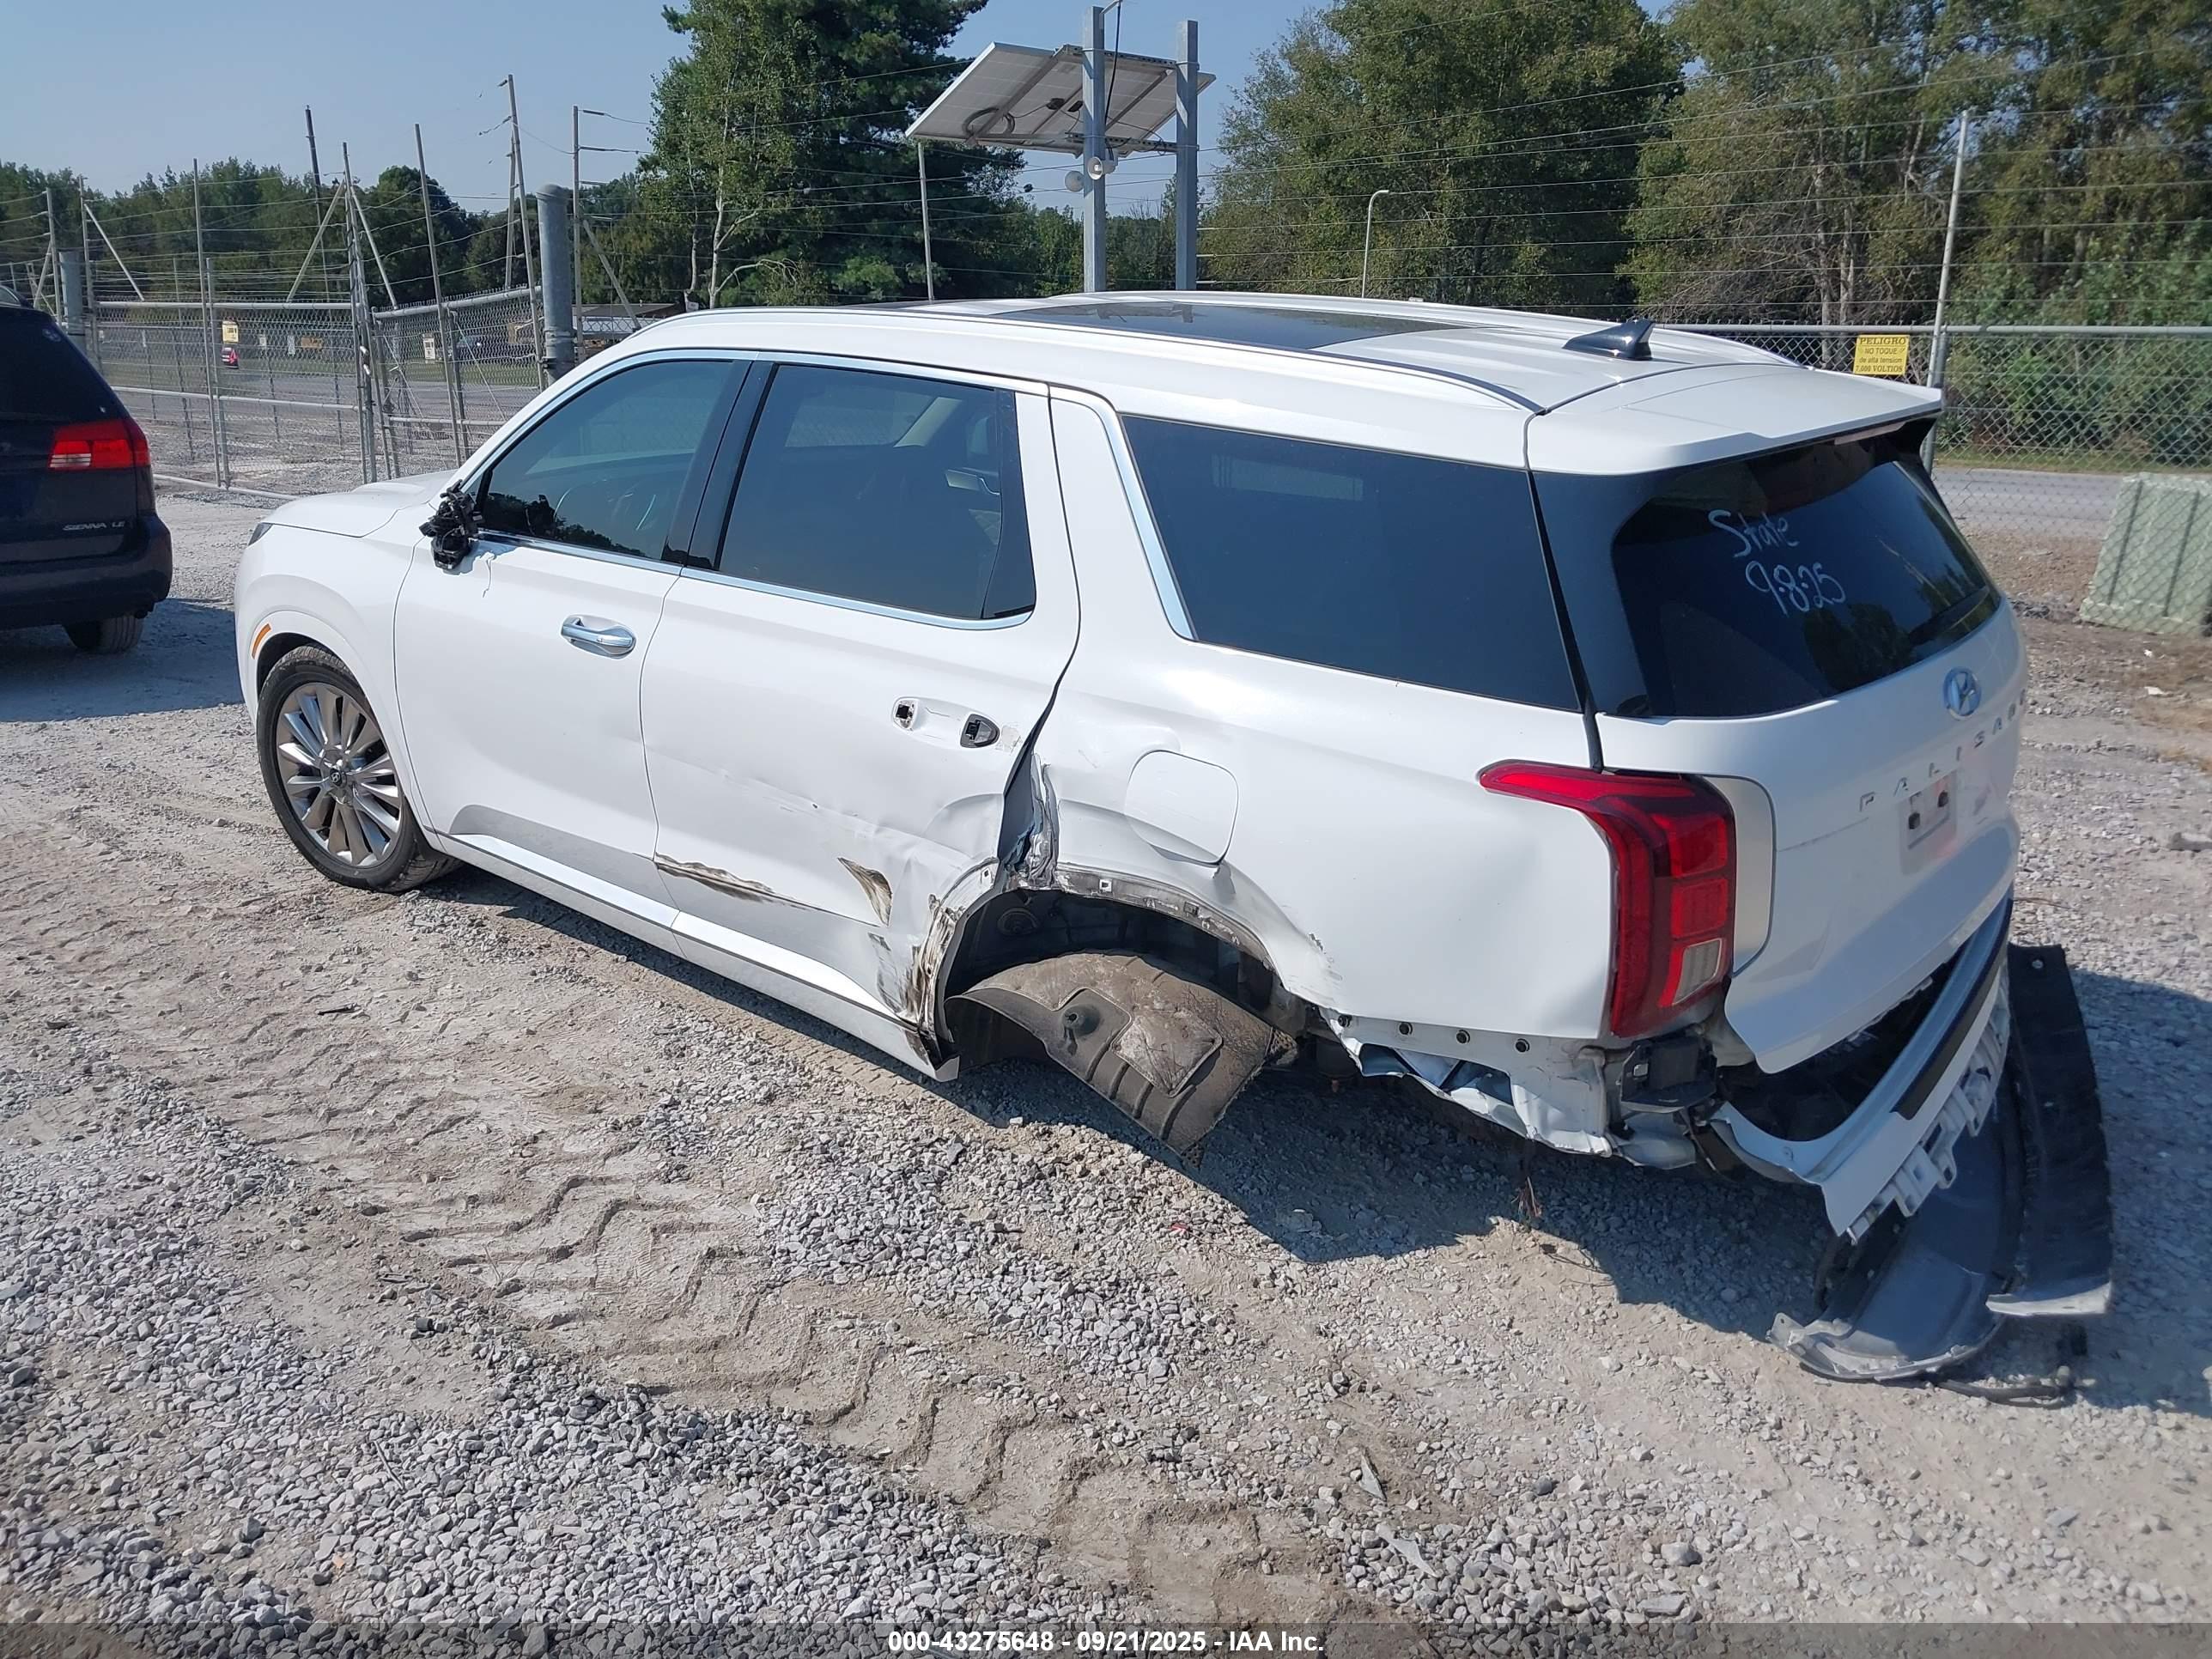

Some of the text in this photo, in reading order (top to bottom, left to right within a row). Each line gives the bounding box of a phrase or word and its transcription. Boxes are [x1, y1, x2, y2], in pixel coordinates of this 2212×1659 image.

[1859, 337, 1906, 345] PELIGRO
[63, 522, 107, 531] SIENNA
[1708, 508, 1800, 558] State
